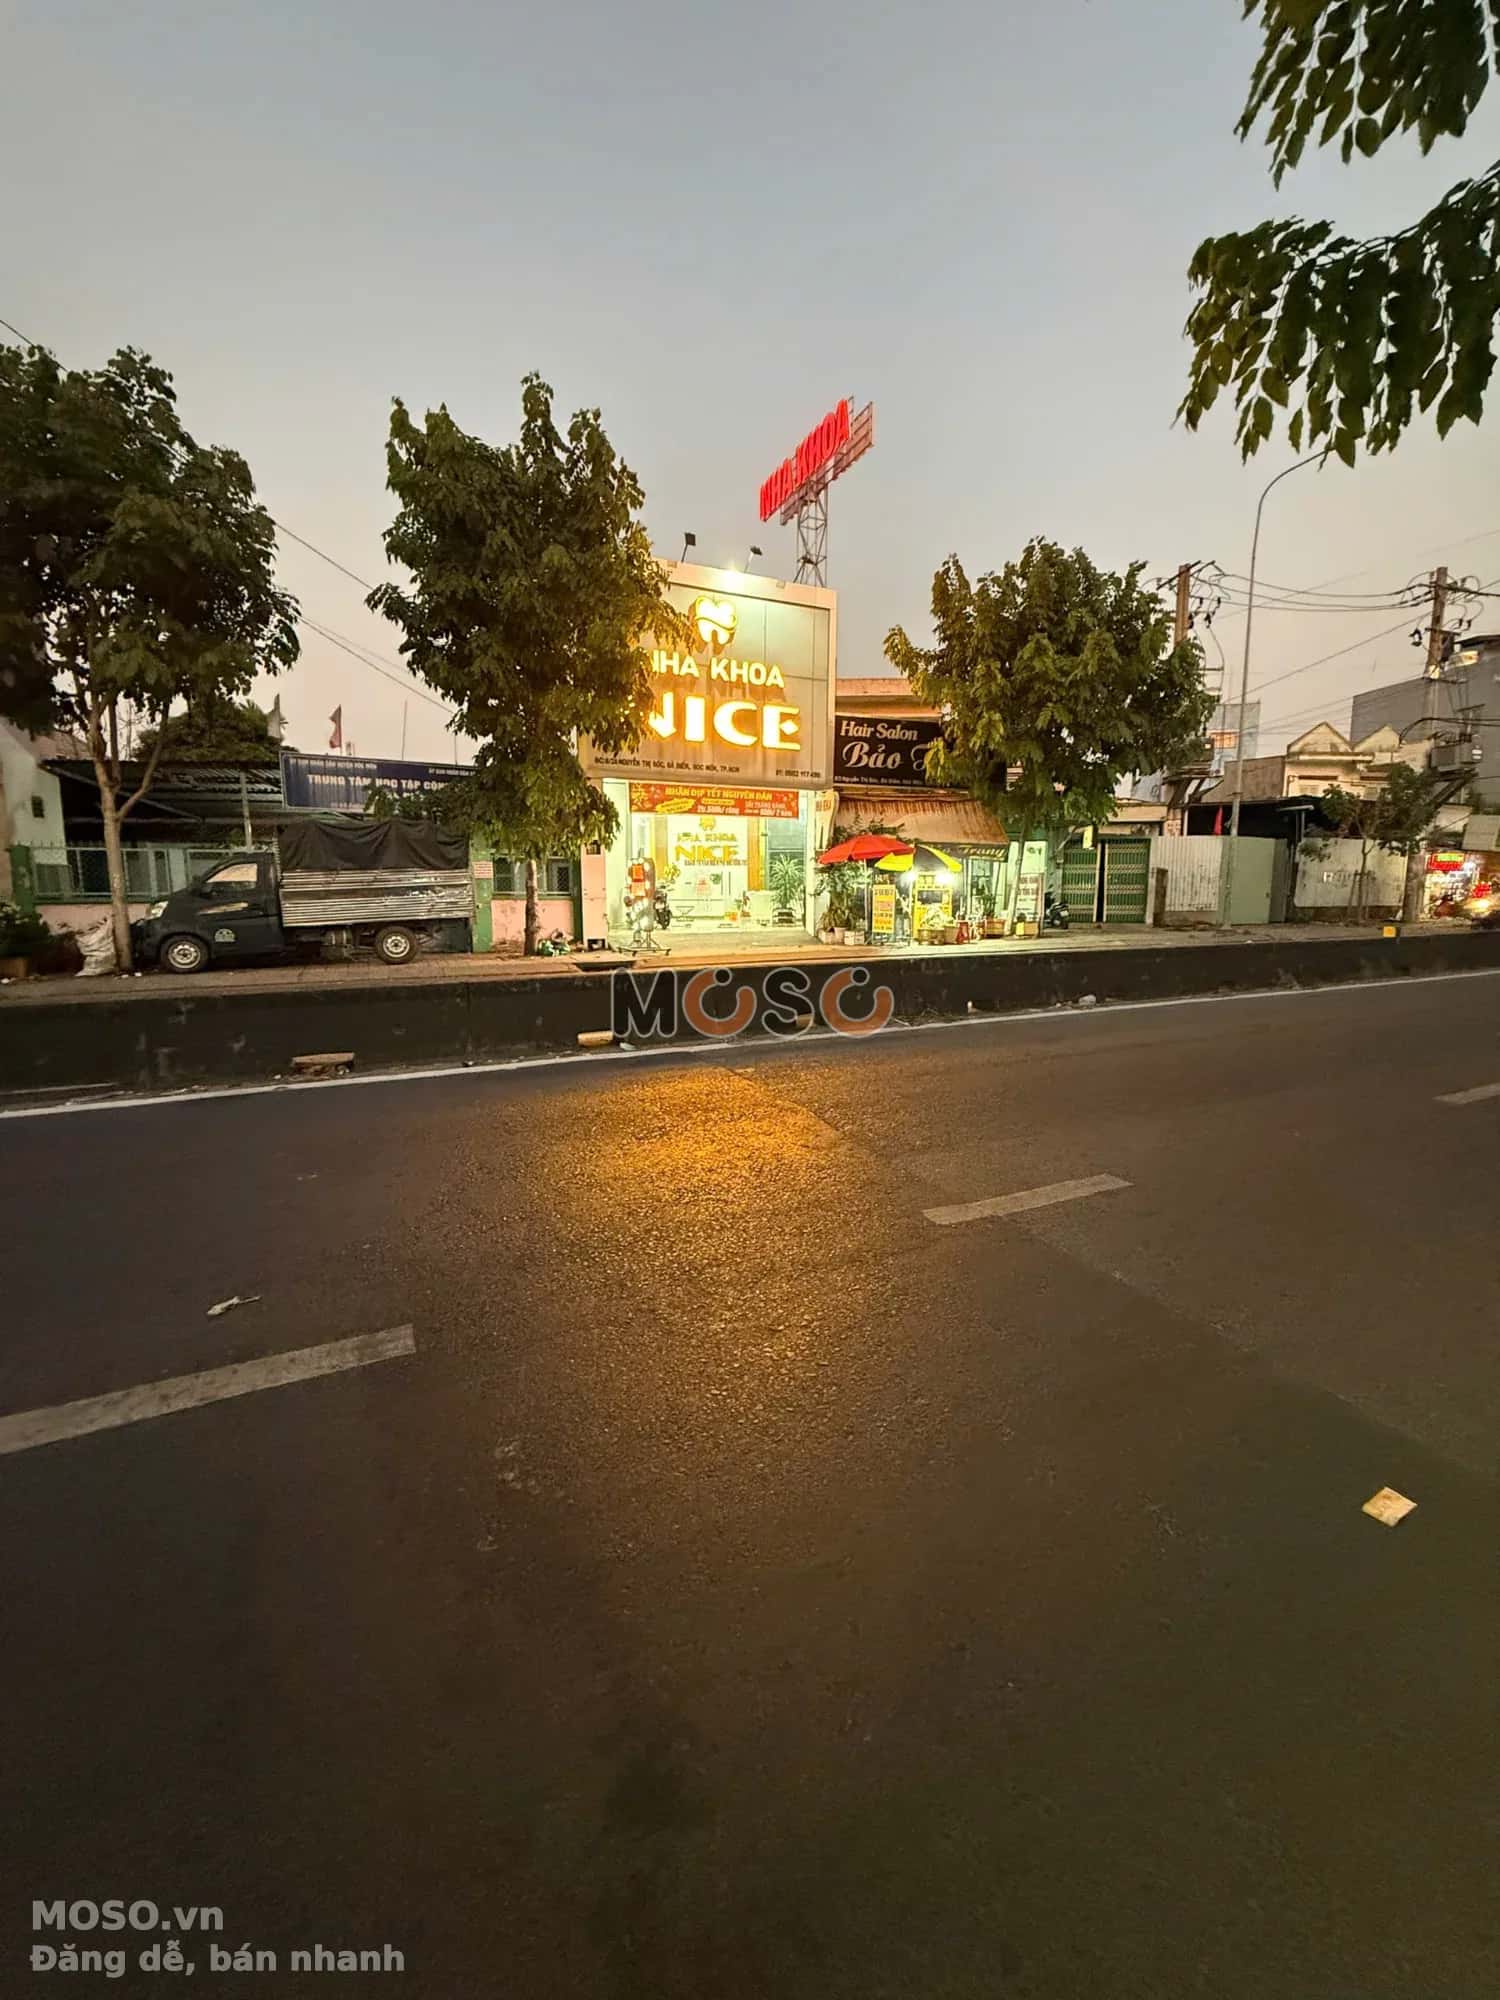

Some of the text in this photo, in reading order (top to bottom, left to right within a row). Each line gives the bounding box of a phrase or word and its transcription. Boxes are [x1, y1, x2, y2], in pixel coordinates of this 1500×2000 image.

[760, 399, 850, 522] NHA KHOA
[710, 656, 785, 688] KHOA
[649, 691, 801, 751] NICE
[839, 719, 918, 740] Hair Salon
[842, 741, 904, 769] Bảo
[307, 774, 346, 785] TRUNG
